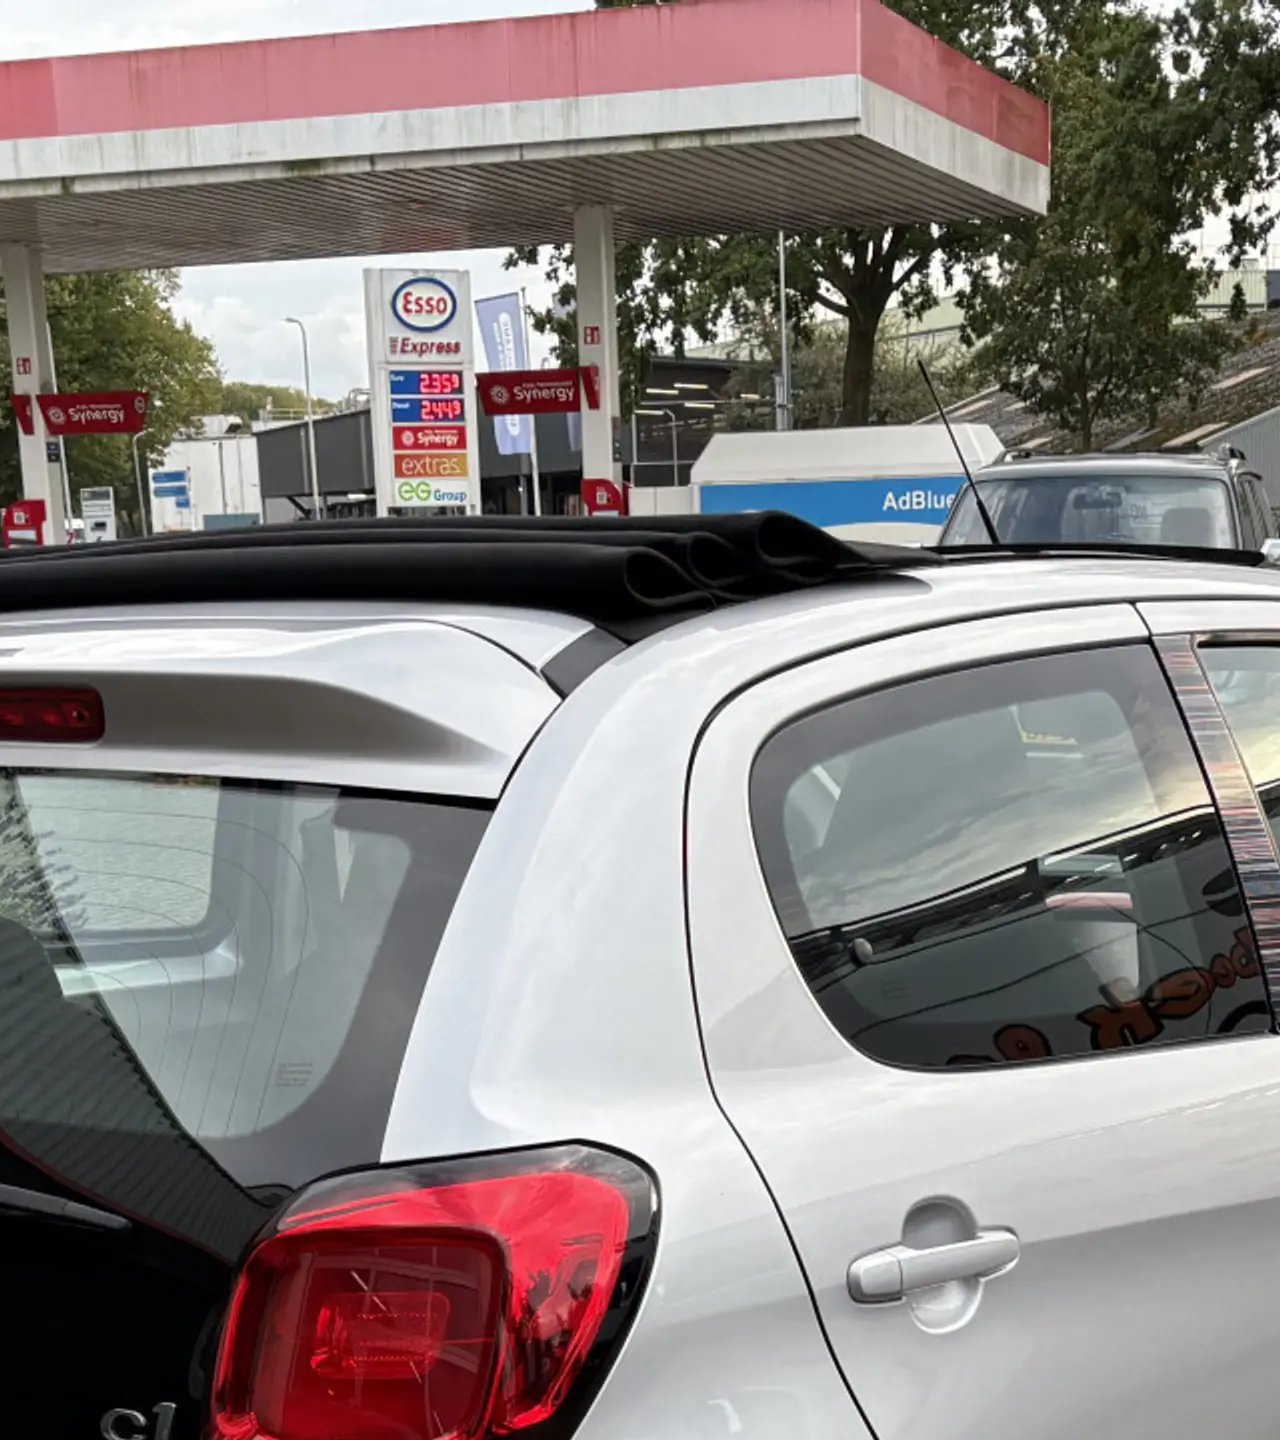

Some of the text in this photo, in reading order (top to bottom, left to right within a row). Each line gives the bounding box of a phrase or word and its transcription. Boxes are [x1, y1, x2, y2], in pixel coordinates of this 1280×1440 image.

[402, 290, 448, 316] Esso
[400, 336, 462, 358] Express
[513, 386, 575, 404] Synergy
[68, 407, 125, 425] Synergy
[417, 431, 459, 447] Synergy
[401, 456, 461, 475] extras
[434, 489, 467, 502] Group
[882, 490, 956, 511] AdBlue
